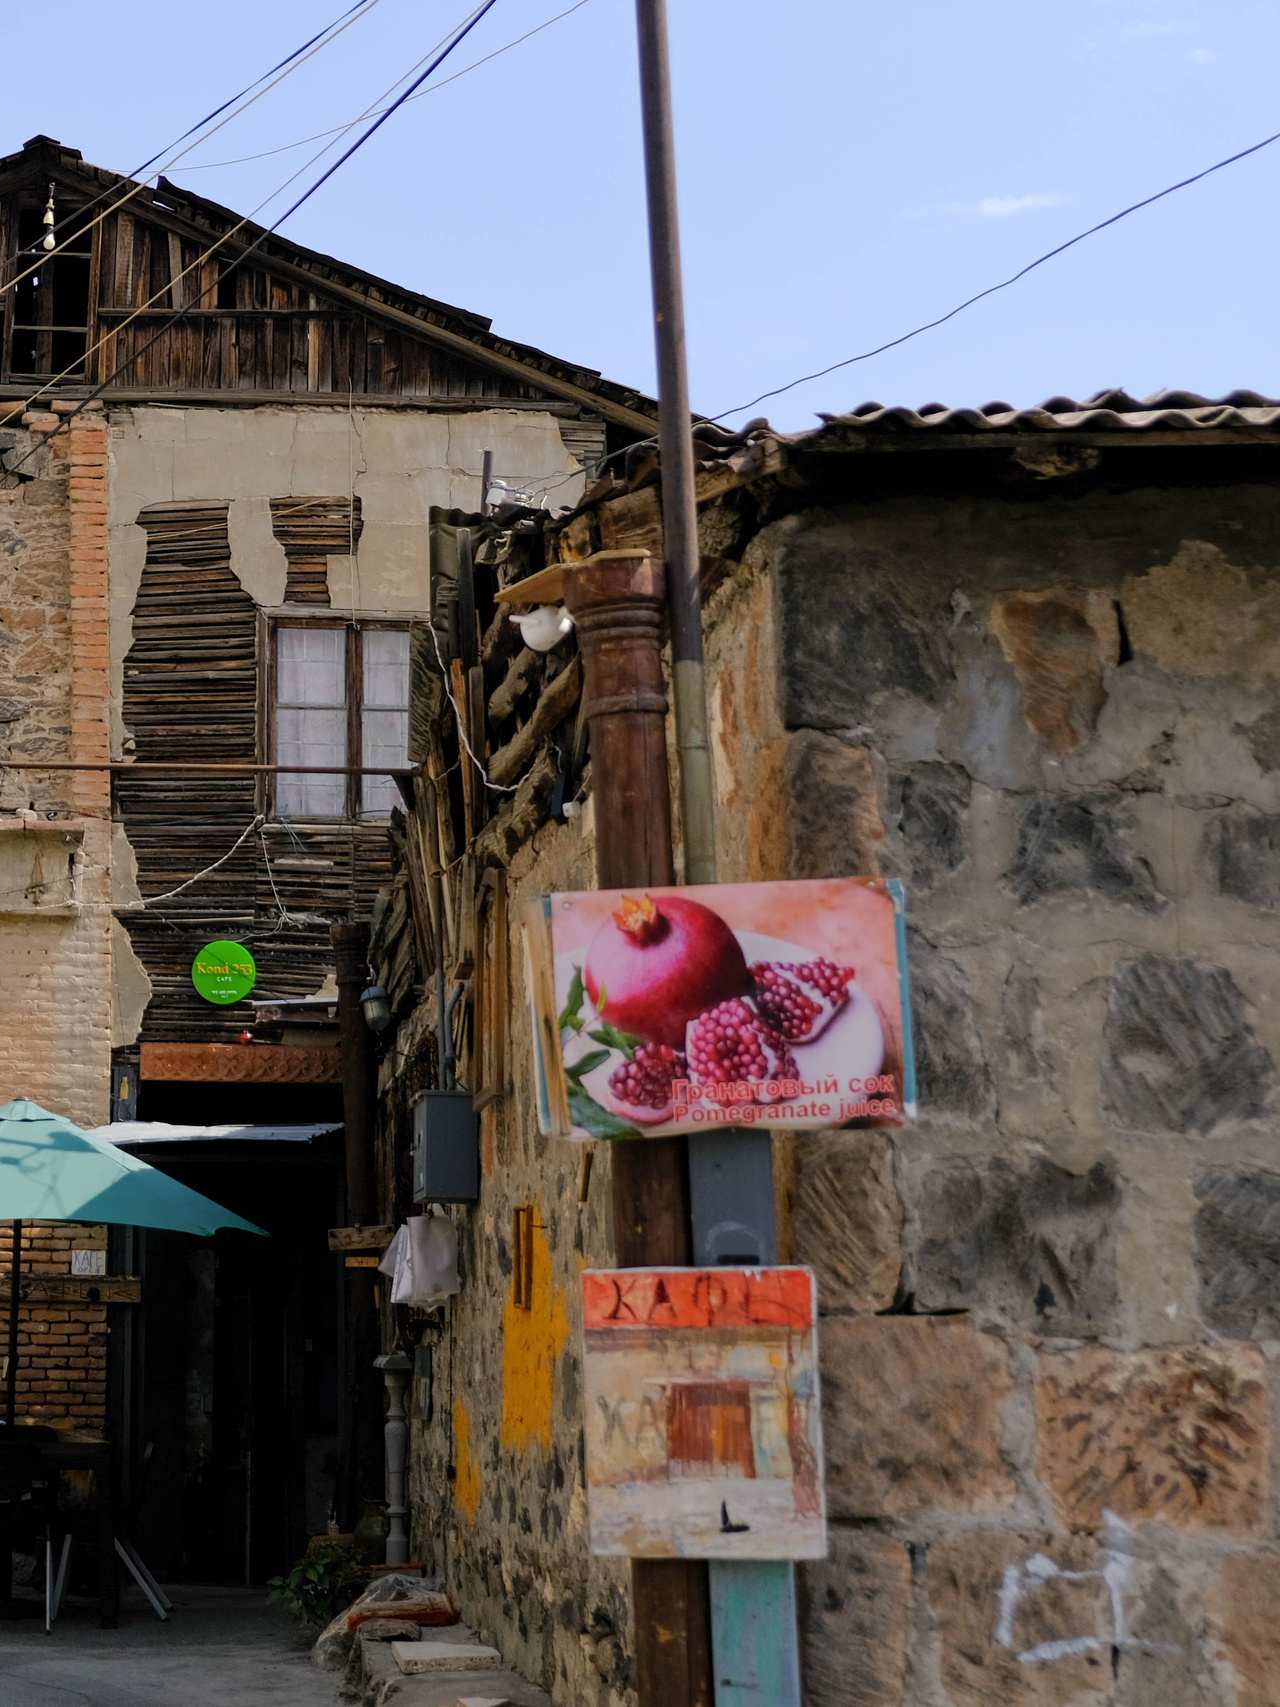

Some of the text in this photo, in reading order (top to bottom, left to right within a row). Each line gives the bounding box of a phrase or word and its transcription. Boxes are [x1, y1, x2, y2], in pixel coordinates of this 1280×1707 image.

[196, 962, 253, 976] Kond 253
[671, 1073, 895, 1102] Гранатовый сок
[674, 1095, 895, 1124] Pomegranate juice
